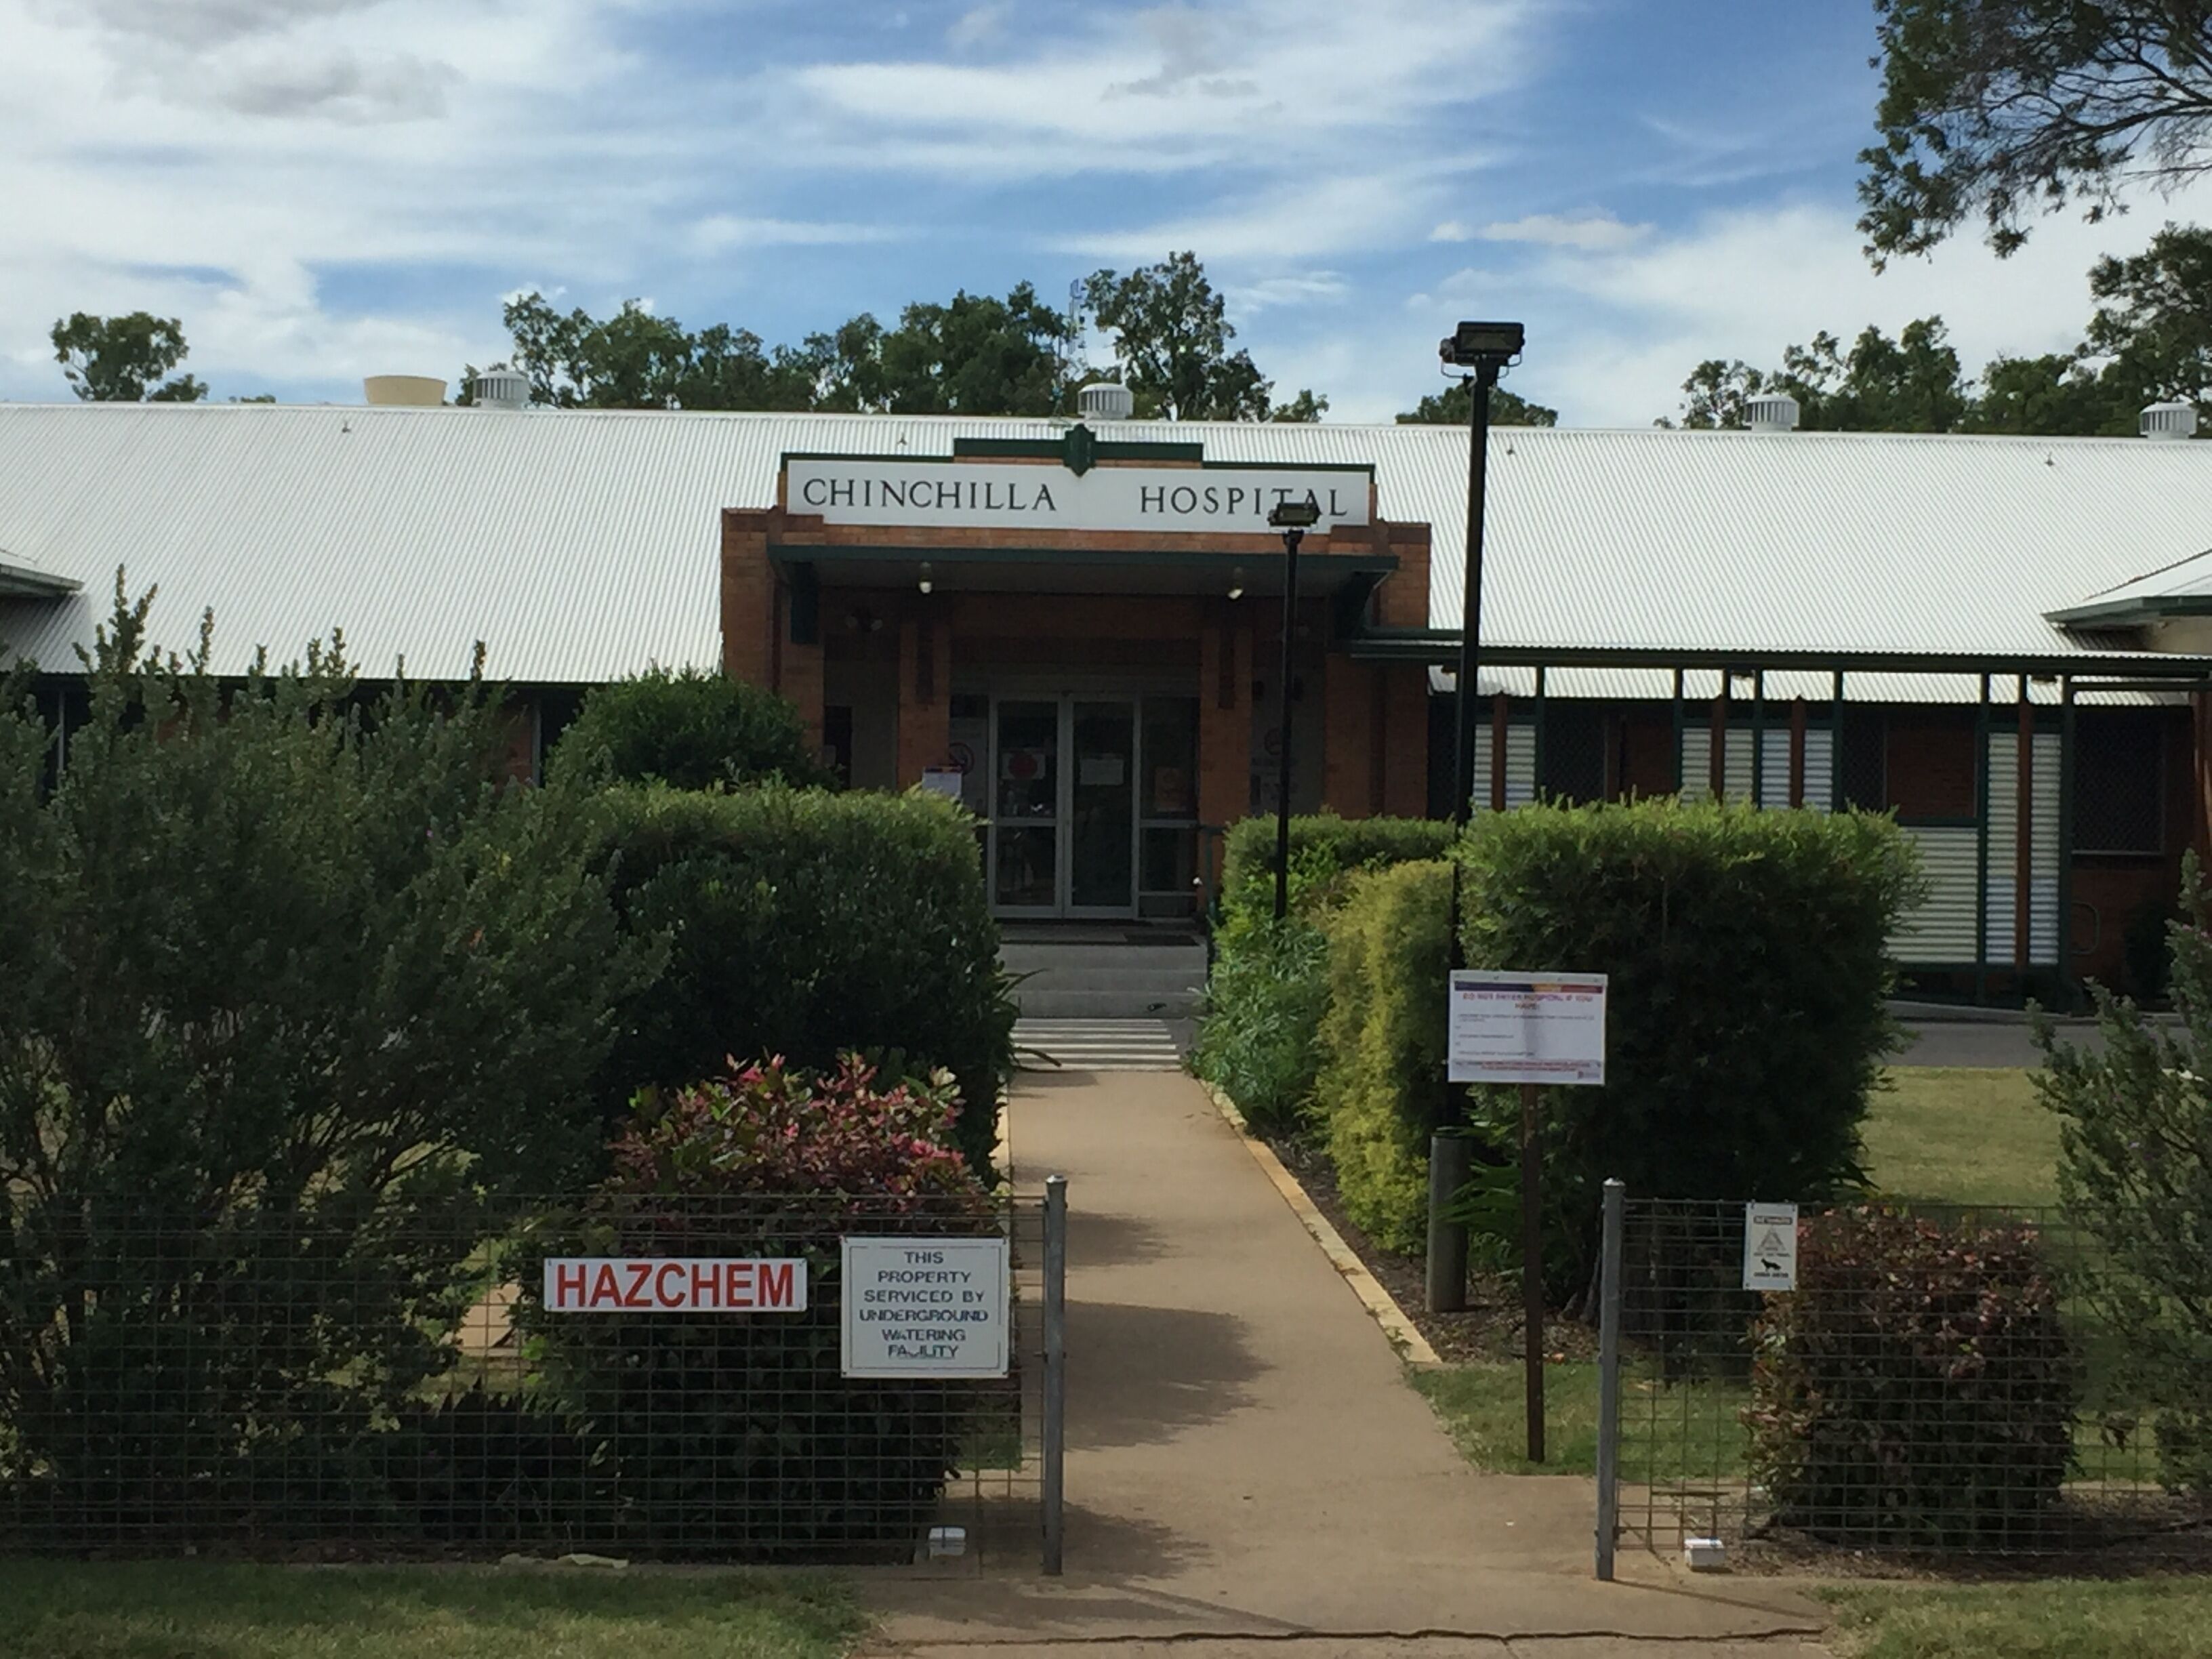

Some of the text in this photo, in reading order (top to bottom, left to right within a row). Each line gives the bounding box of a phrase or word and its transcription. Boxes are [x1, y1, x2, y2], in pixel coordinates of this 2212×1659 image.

[803, 478, 1349, 516] CHINCHILLA HOSPITAL
[905, 1251, 944, 1264] THIS
[877, 1270, 971, 1284] PROPERTY
[556, 1263, 795, 1308] HAZCHEM
[863, 1290, 985, 1303] SERVICED BY
[859, 1309, 989, 1322] UNDERGROUND
[882, 1328, 966, 1342] WATERING
